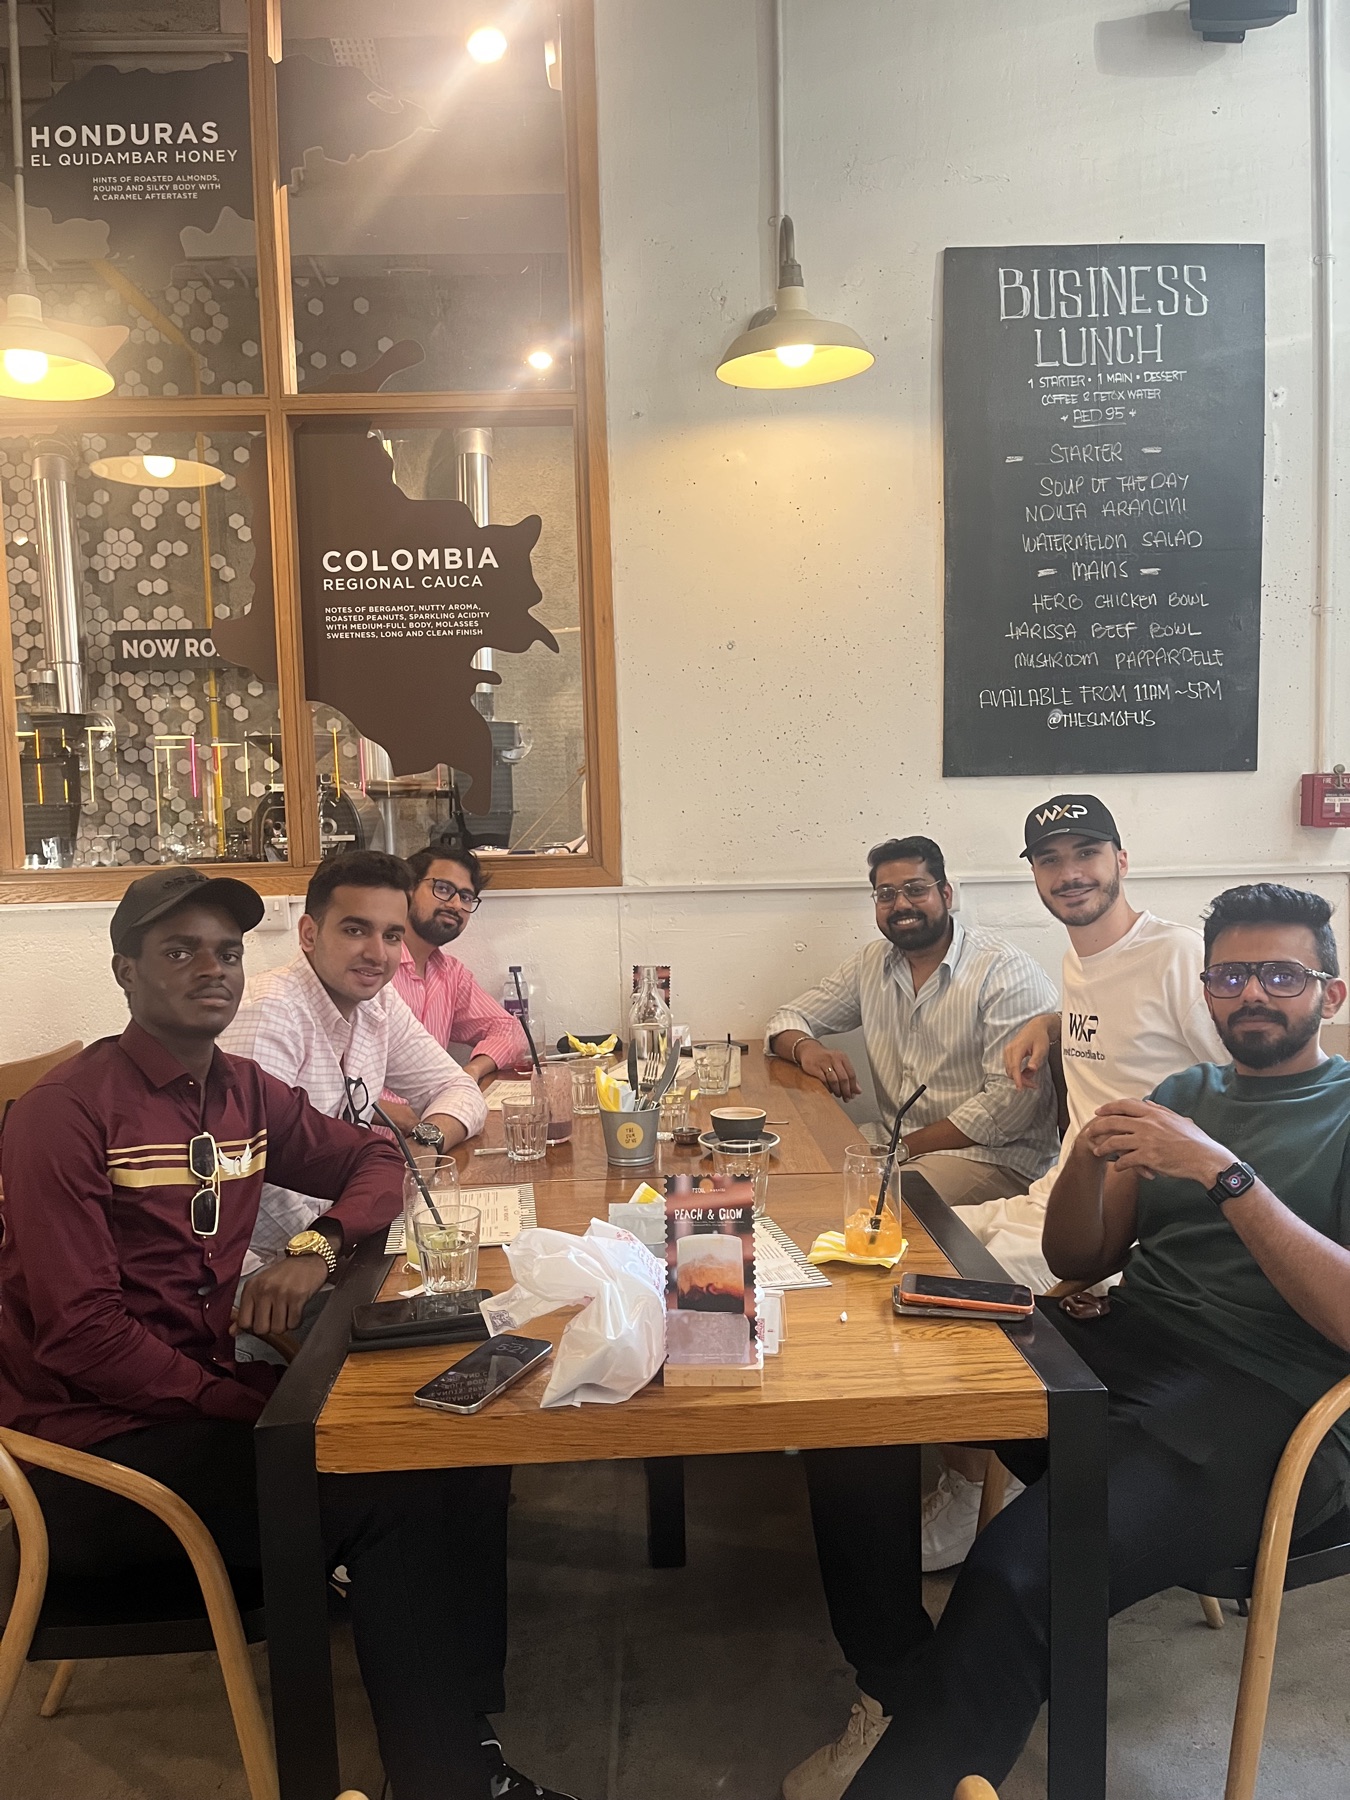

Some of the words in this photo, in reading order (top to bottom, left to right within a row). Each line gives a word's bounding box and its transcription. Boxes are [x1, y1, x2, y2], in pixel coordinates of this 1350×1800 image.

[31, 122, 219, 148] HONDURAS
[31, 154, 51, 167] EL
[59, 151, 168, 166] QUIDAMBAR
[175, 150, 238, 163] HONEY
[134, 175, 173, 183] ROASTED
[102, 193, 143, 201] CARAMEL
[145, 192, 198, 200] AFTERTASTE
[999, 265, 1209, 321] BUSINESS
[1034, 323, 1163, 367] LUNCH
[1028, 379, 1034, 388] 1
[1039, 375, 1086, 388] STARTER
[1097, 373, 1102, 384] 1
[1107, 373, 1132, 383] MAIN
[1143, 371, 1187, 383] DESSERT
[1042, 394, 1078, 406] COFFEE
[1083, 392, 1090, 402] &
[1127, 389, 1161, 399] WATER
[1073, 409, 1103, 423] AED
[1105, 406, 1125, 420] 95
[1050, 442, 1123, 464] STARTER
[1039, 476, 1084, 497] SOUP
[1091, 477, 1111, 493] OF
[1116, 476, 1148, 492] THE
[1150, 472, 1189, 491] DAY
[1022, 533, 1127, 553] WATERMELON
[1142, 529, 1203, 548] SALAD
[322, 547, 499, 573] COLOMBIA
[1072, 560, 1129, 581] MAINS
[323, 576, 415, 591] REGIONAL
[421, 575, 483, 589] CAUCA
[368, 605, 417, 613] BERGAMOT,
[1032, 593, 1083, 613] HERB
[1095, 592, 1157, 609] CHICKEN
[1168, 592, 1209, 607] BOWL
[350, 622, 406, 630] MEDIUM-FULL
[409, 621, 433, 629] BODY,
[435, 620, 479, 628] MOLASSES
[409, 612, 455, 620] SPARKLING
[457, 611, 490, 619] ACIDITY
[326, 631, 378, 639] SWEETNESS,
[1091, 621, 1138, 639] BEEF
[1149, 622, 1202, 638] BOWL
[122, 638, 180, 659] NOW
[185, 637, 220, 658] RO
[1014, 651, 1099, 668] MUSHROOM
[1115, 647, 1224, 669] PAPPARDELLE
[979, 686, 1073, 708] AVAILABLE
[1079, 685, 1127, 703] FROM
[1134, 683, 1170, 702] 11AM
[1035, 804, 1088, 826] WXP
[674, 1208, 703, 1220] PEACH
[707, 1209, 715, 1220] &
[719, 1208, 743, 1220] GLOW
